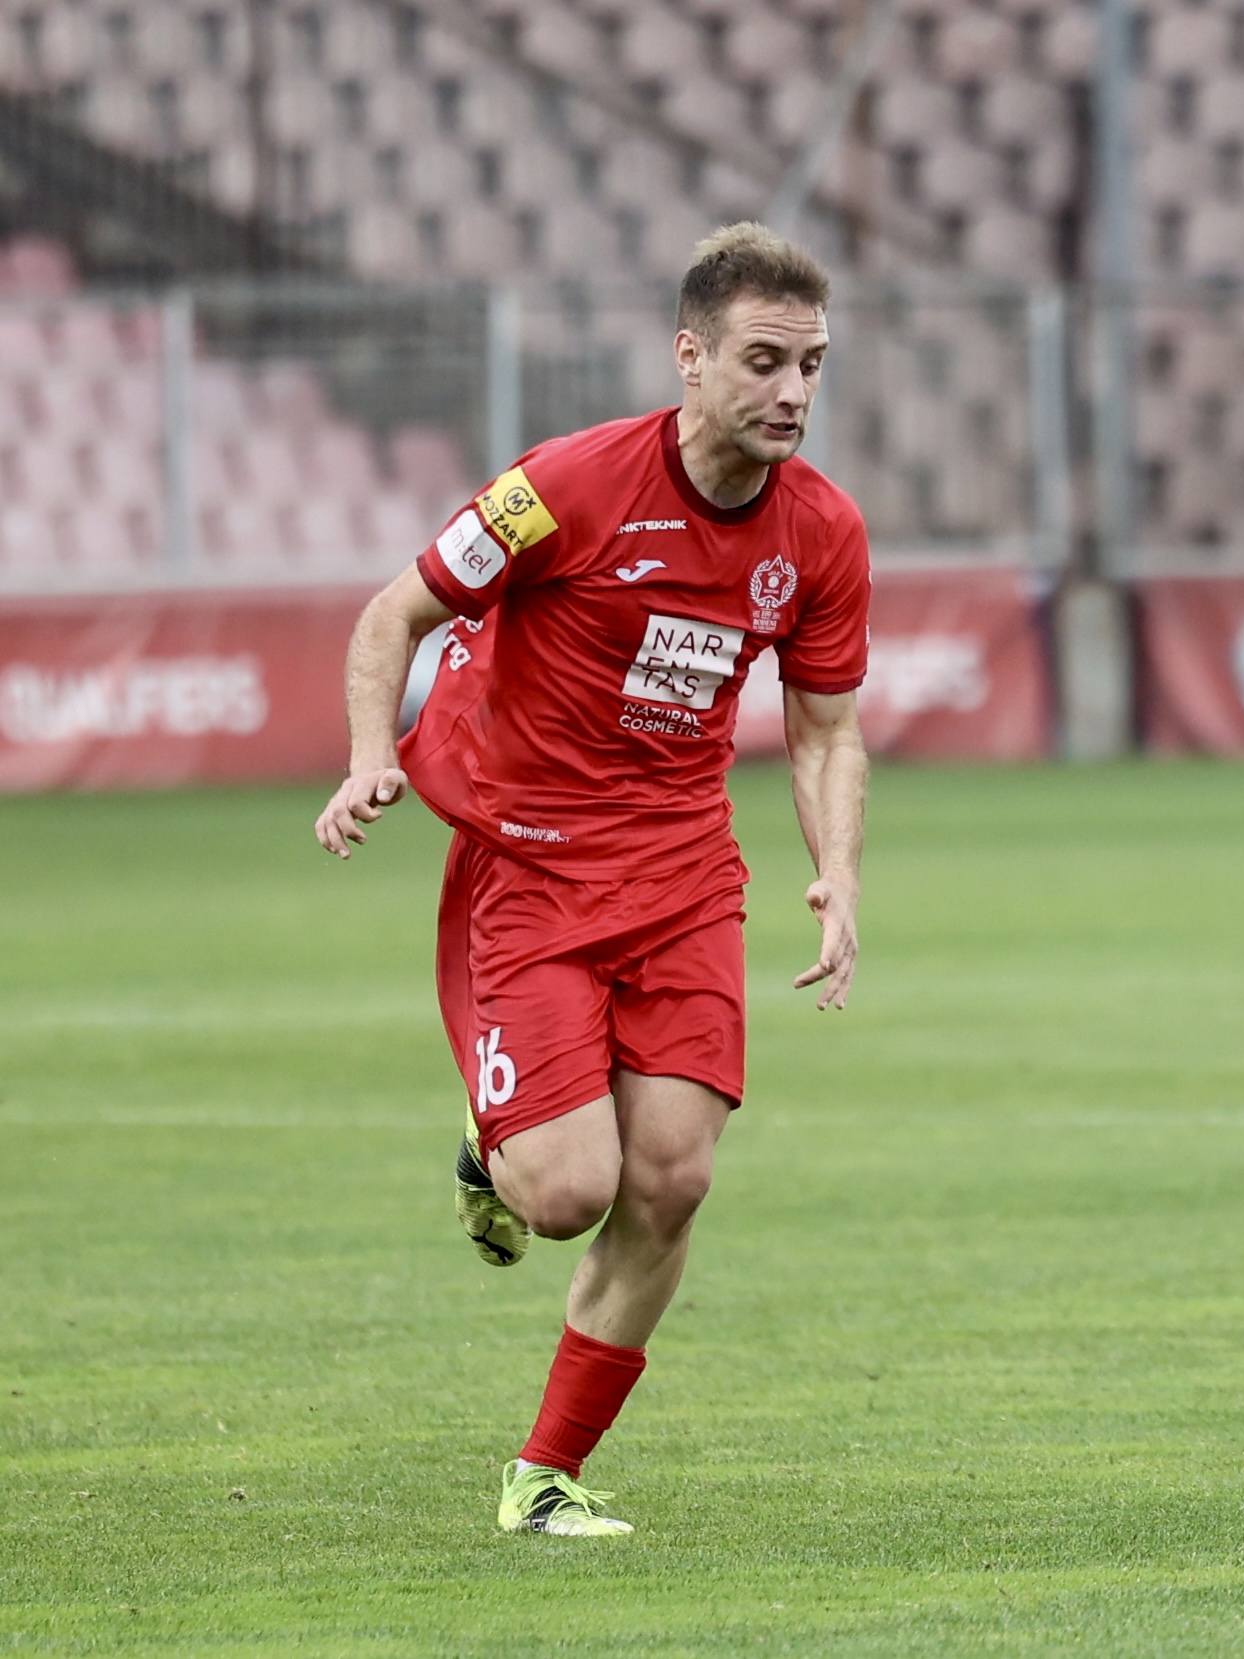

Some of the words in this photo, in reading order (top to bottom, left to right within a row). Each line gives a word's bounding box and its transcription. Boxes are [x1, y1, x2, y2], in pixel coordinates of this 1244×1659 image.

[483, 494, 524, 548] MOZZART
[651, 627, 724, 657] NAR
[641, 666, 701, 699] TAS
[619, 714, 704, 738] COSMETIC
[623, 702, 701, 726] NATURAL
[475, 1026, 517, 1114] 16
